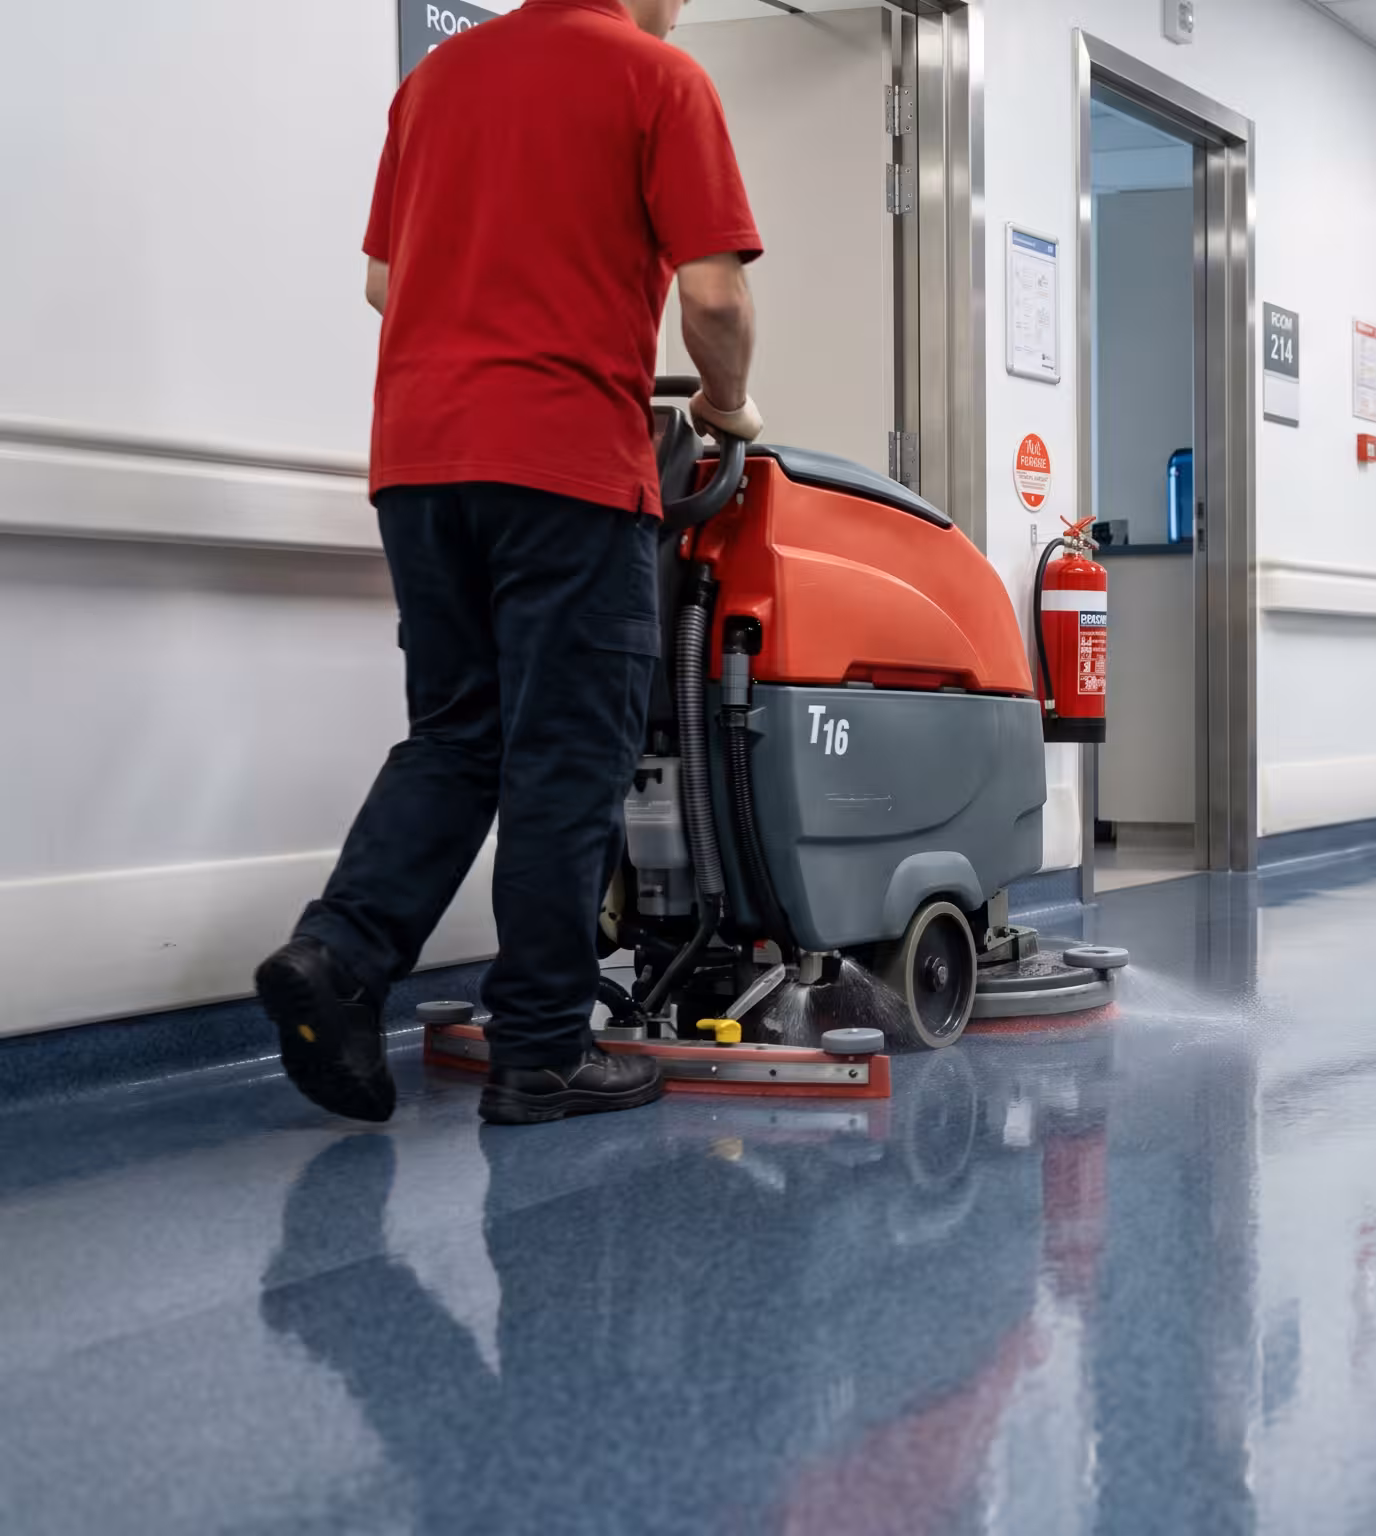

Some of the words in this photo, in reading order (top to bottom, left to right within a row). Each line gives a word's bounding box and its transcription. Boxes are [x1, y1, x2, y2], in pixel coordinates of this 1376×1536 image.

[426, 3, 480, 36] ROO
[1270, 333, 1294, 364] 214
[807, 704, 850, 756] T16
